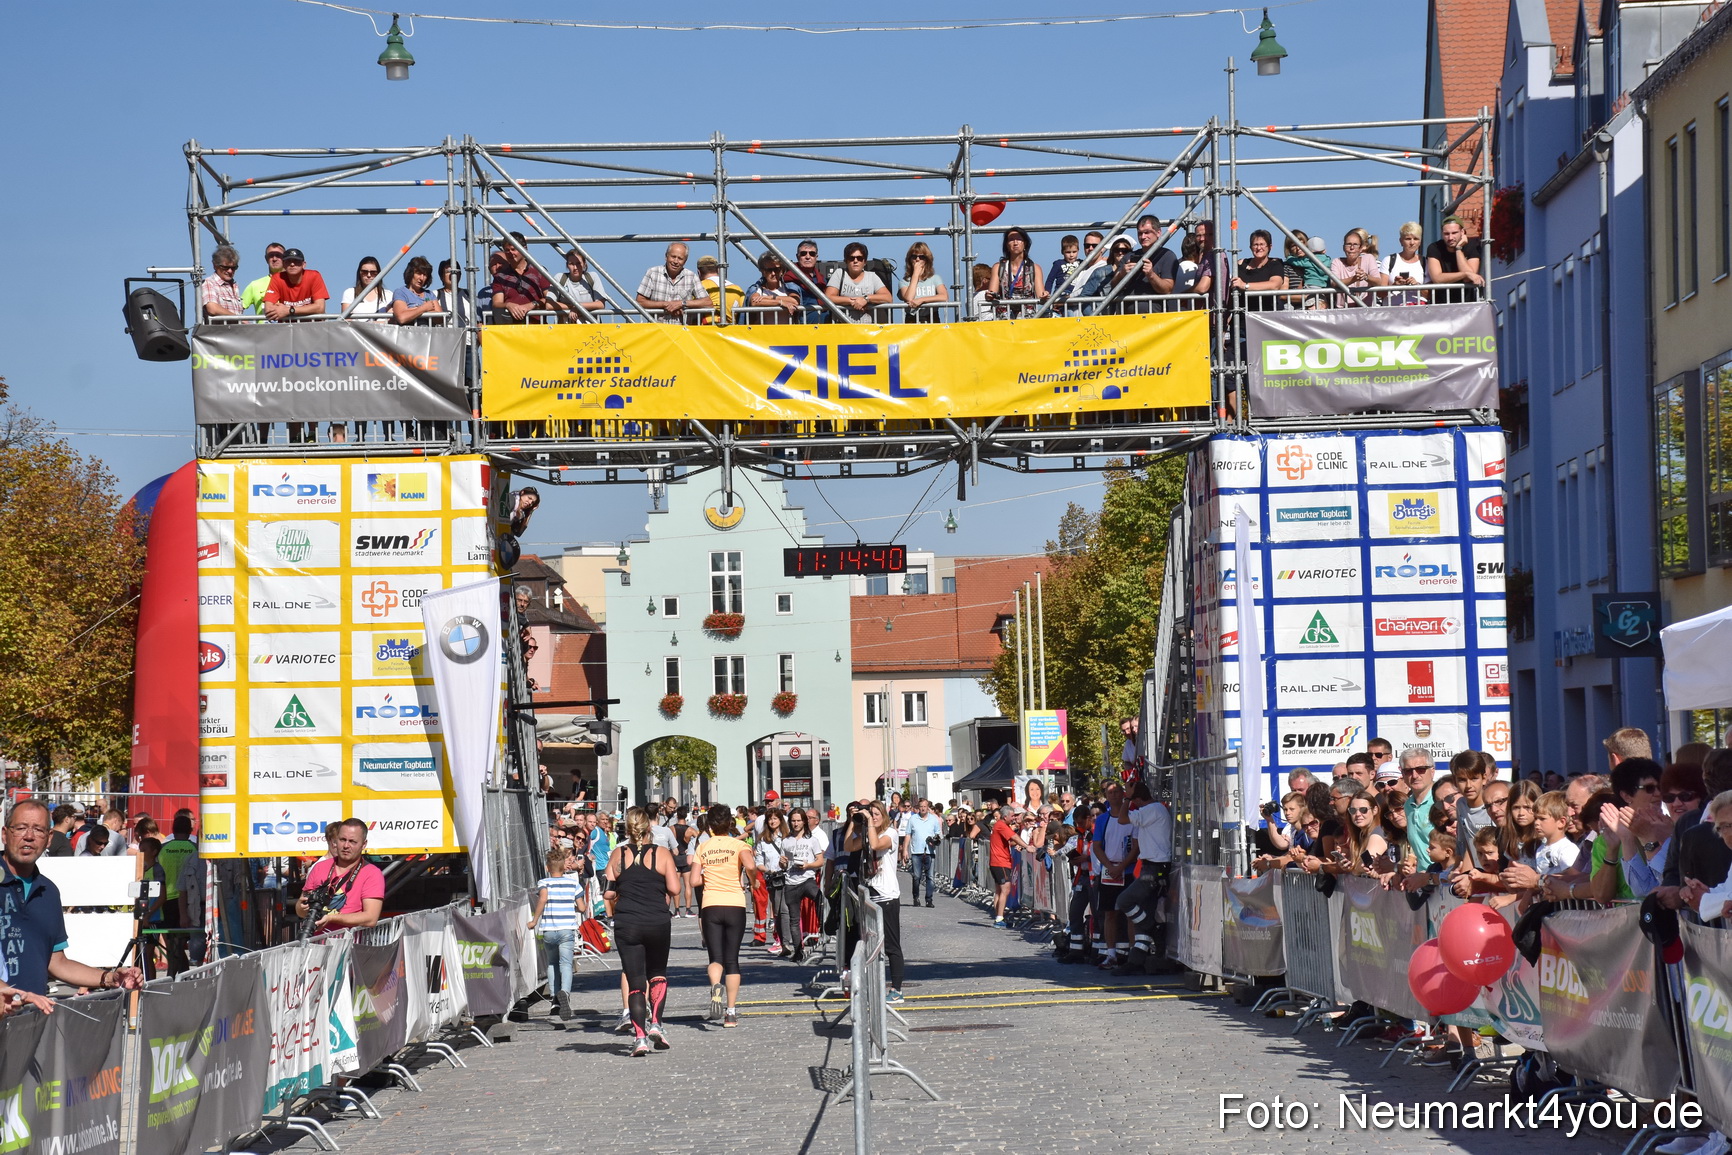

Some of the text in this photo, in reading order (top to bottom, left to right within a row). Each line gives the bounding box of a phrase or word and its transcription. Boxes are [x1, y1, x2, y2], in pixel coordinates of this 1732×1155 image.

[1266, 339, 1425, 371] BOCK
[192, 351, 439, 371] OFFICE INDUSTRY LOUNGE
[766, 343, 928, 400] ZIEL
[1018, 363, 1172, 384] Neumarkter Stadtlauf
[227, 375, 408, 393] www.bockonline.de
[520, 375, 677, 389] Neumarkter Stadtlauf
[1263, 373, 1430, 389] inspired by smart concepts
[1316, 452, 1343, 461] CODE
[1317, 461, 1348, 470] CLINIC
[1370, 460, 1427, 469] RAIL.ONE
[297, 496, 336, 505] energie
[1280, 509, 1348, 519] Neumarkter Tagblatt
[1392, 504, 1436, 520] Burgis
[355, 535, 410, 549] swn
[797, 547, 903, 572] 11:14:40
[1298, 568, 1357, 579] VARIOTEC
[1476, 562, 1506, 574] sw
[1419, 576, 1457, 585] energie
[252, 601, 312, 609] RAIL.ONE
[1378, 620, 1438, 632] charivari
[1617, 610, 1641, 636] G2
[376, 644, 420, 661] Burgis
[275, 654, 336, 664] VARIOTEC
[1281, 685, 1338, 693] RAIL.ONE
[1407, 684, 1433, 695] Braun
[400, 717, 438, 726] energie
[1282, 732, 1336, 748] swn
[1395, 748, 1454, 759] Lbräu
[363, 760, 432, 770] Neumarkter Tagblatt
[253, 770, 312, 779] RAIL.ONE
[379, 819, 439, 830] VARIOTEC
